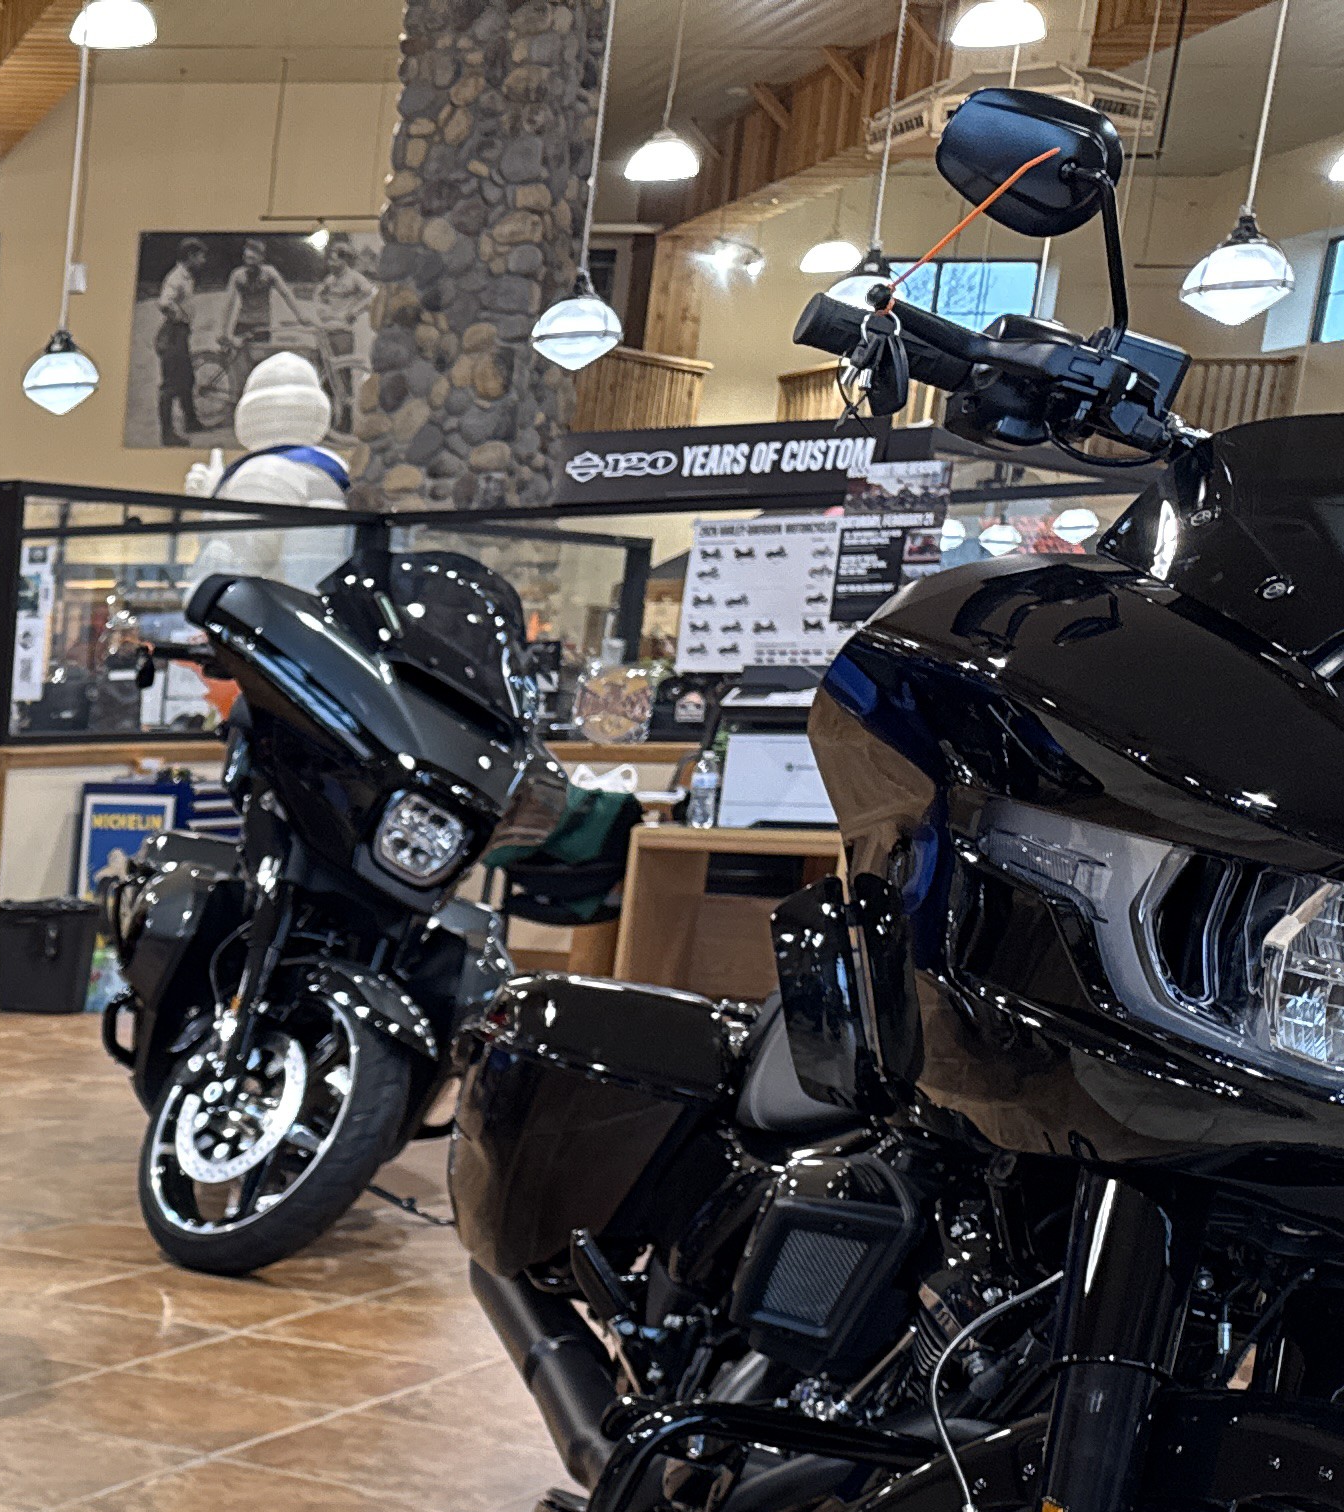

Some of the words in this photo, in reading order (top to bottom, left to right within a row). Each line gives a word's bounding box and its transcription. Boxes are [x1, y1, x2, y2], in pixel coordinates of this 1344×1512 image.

[681, 443, 748, 477] YEARS
[750, 441, 782, 475] OF
[782, 436, 877, 477] CUSTOM
[92, 813, 162, 830] MICHELIN
